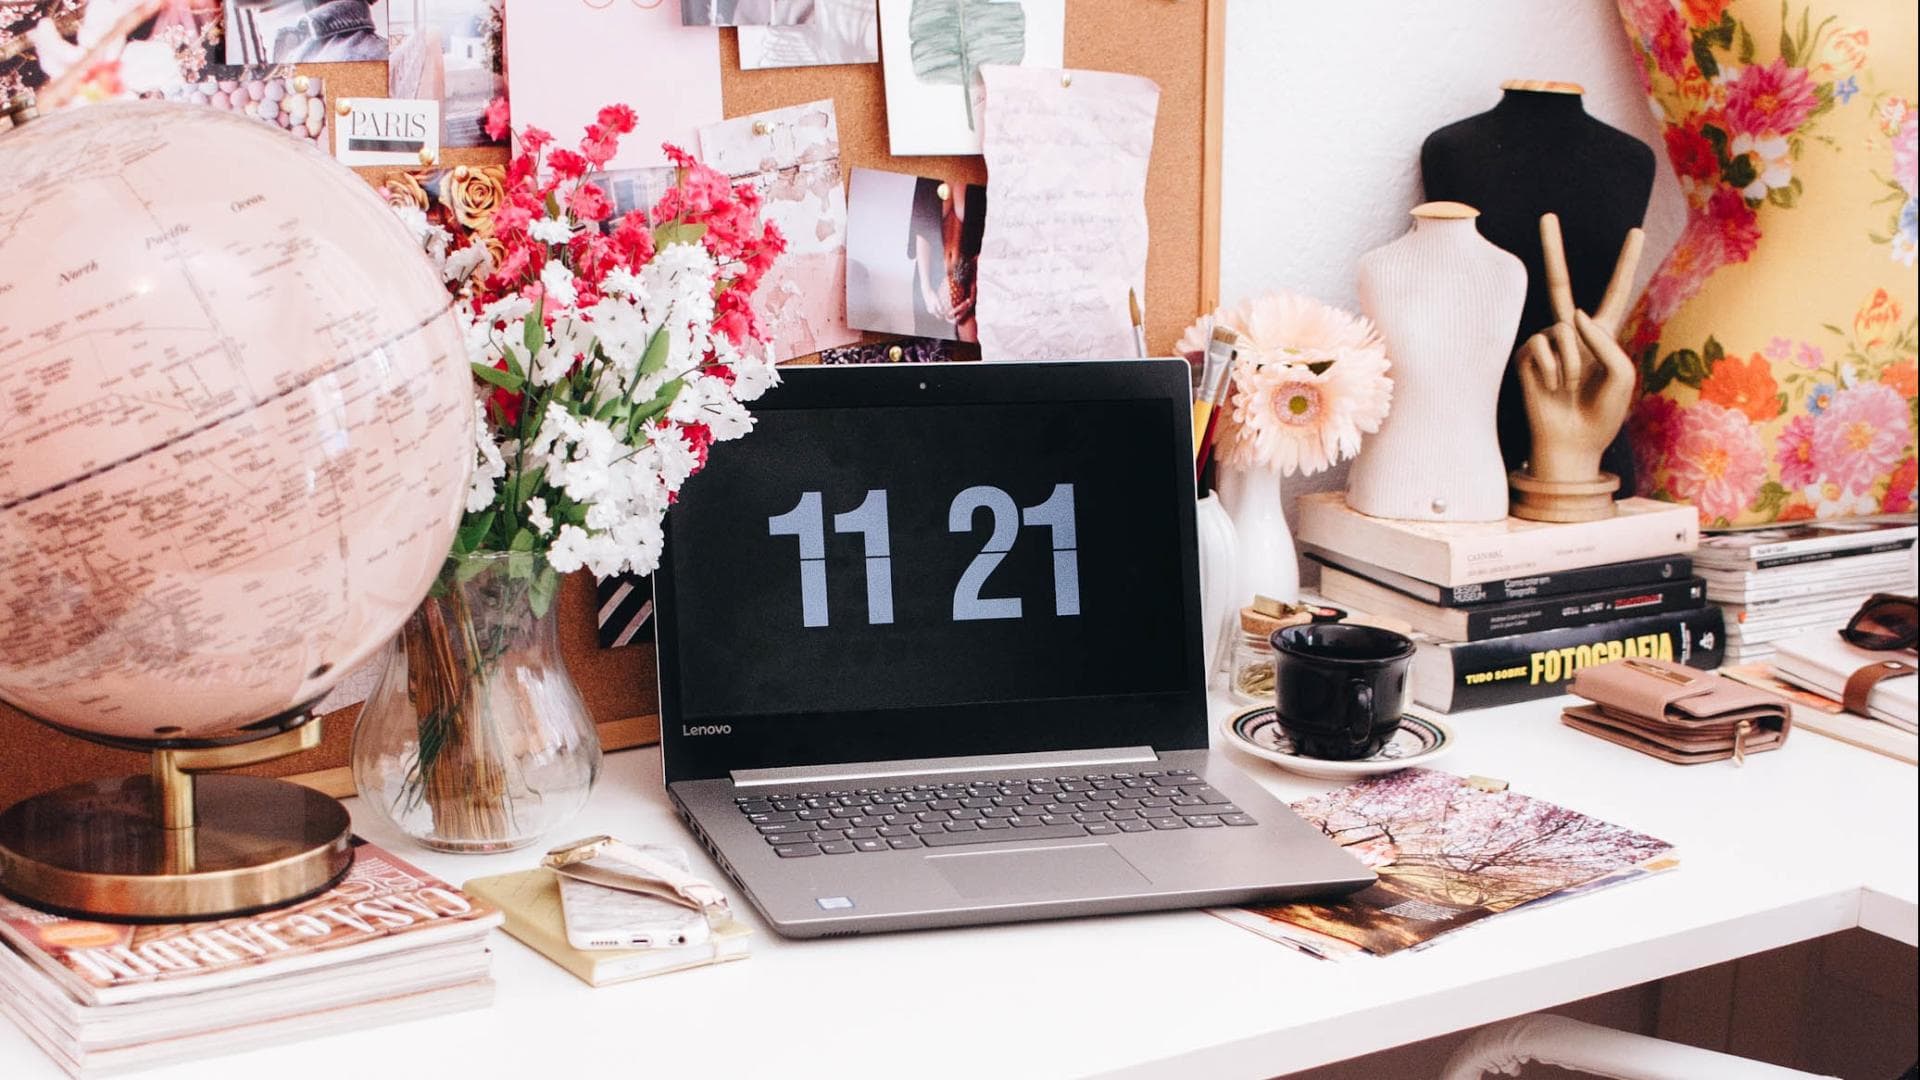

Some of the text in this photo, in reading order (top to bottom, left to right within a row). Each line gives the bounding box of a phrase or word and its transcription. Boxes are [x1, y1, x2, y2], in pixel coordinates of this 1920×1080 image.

[350, 110, 426, 138] PARIS
[57, 260, 100, 286] North
[144, 222, 192, 250] Pacific
[768, 482, 1081, 628] 11 21
[1465, 672, 1494, 686] TUDO
[1494, 665, 1528, 682] SOBRE
[682, 723, 732, 738] Lenovo
[323, 886, 473, 934] CASA
[65, 922, 294, 981] JARDIM
